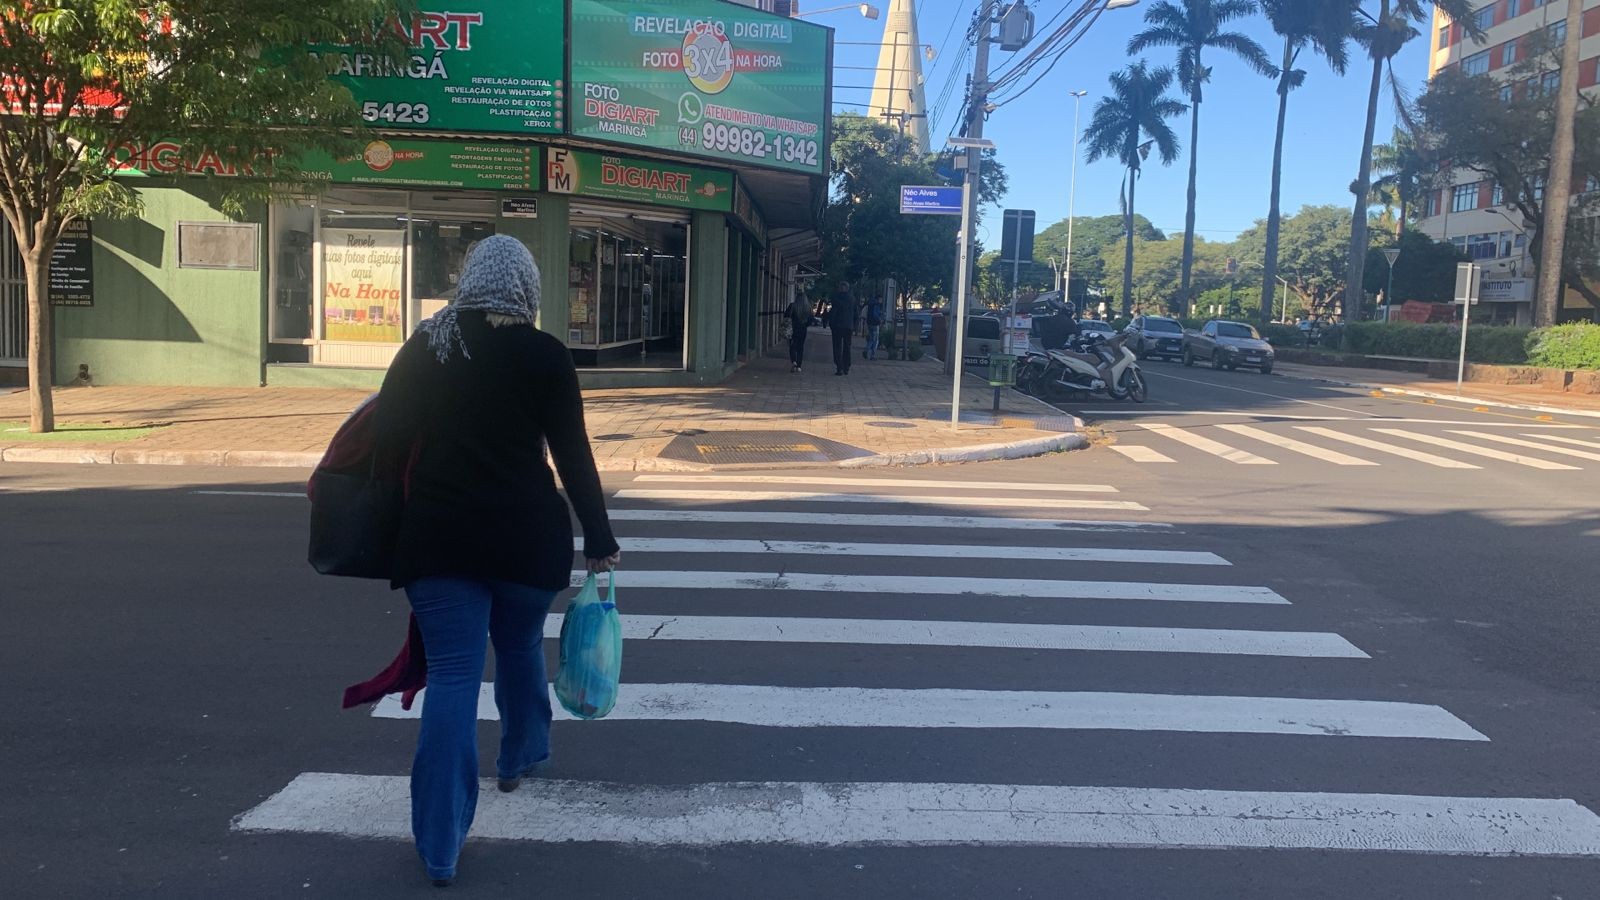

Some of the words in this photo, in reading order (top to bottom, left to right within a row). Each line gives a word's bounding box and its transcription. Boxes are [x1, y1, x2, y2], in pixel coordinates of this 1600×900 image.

[634, 16, 726, 36] REVELAÇÃO
[734, 22, 788, 39] DIGITAL
[642, 52, 679, 68] FOTO
[736, 54, 751, 67] NA
[753, 55, 782, 67] HORA
[471, 77, 519, 86] REVELAÇÃO
[521, 79, 552, 87] DIGITAL
[444, 86, 492, 95] REVELAÇÃO
[508, 89, 552, 97] WHATSAPP
[584, 82, 620, 101] FOTO
[451, 96, 510, 106] RESTAURAÇÃO
[362, 101, 430, 123] 5423
[489, 109, 552, 118] PLASTIFICAÇÃO
[585, 97, 660, 127] DIGIART
[704, 103, 764, 127] ATENDIMENTO
[763, 113, 777, 129] VIA
[776, 115, 818, 137] WHATSAPP
[524, 120, 552, 128] XEROX
[598, 120, 648, 138] MARINGÁ
[679, 126, 698, 148] (44)
[702, 121, 818, 166] 99982-1342
[602, 155, 621, 165] FOTO
[601, 162, 692, 194] DIGIART
[346, 233, 376, 248] Revele
[343, 249, 366, 266] fotos
[367, 249, 402, 267] digitais
[351, 266, 373, 282] aqui
[326, 281, 351, 298] Na
[355, 283, 400, 300] Hora
